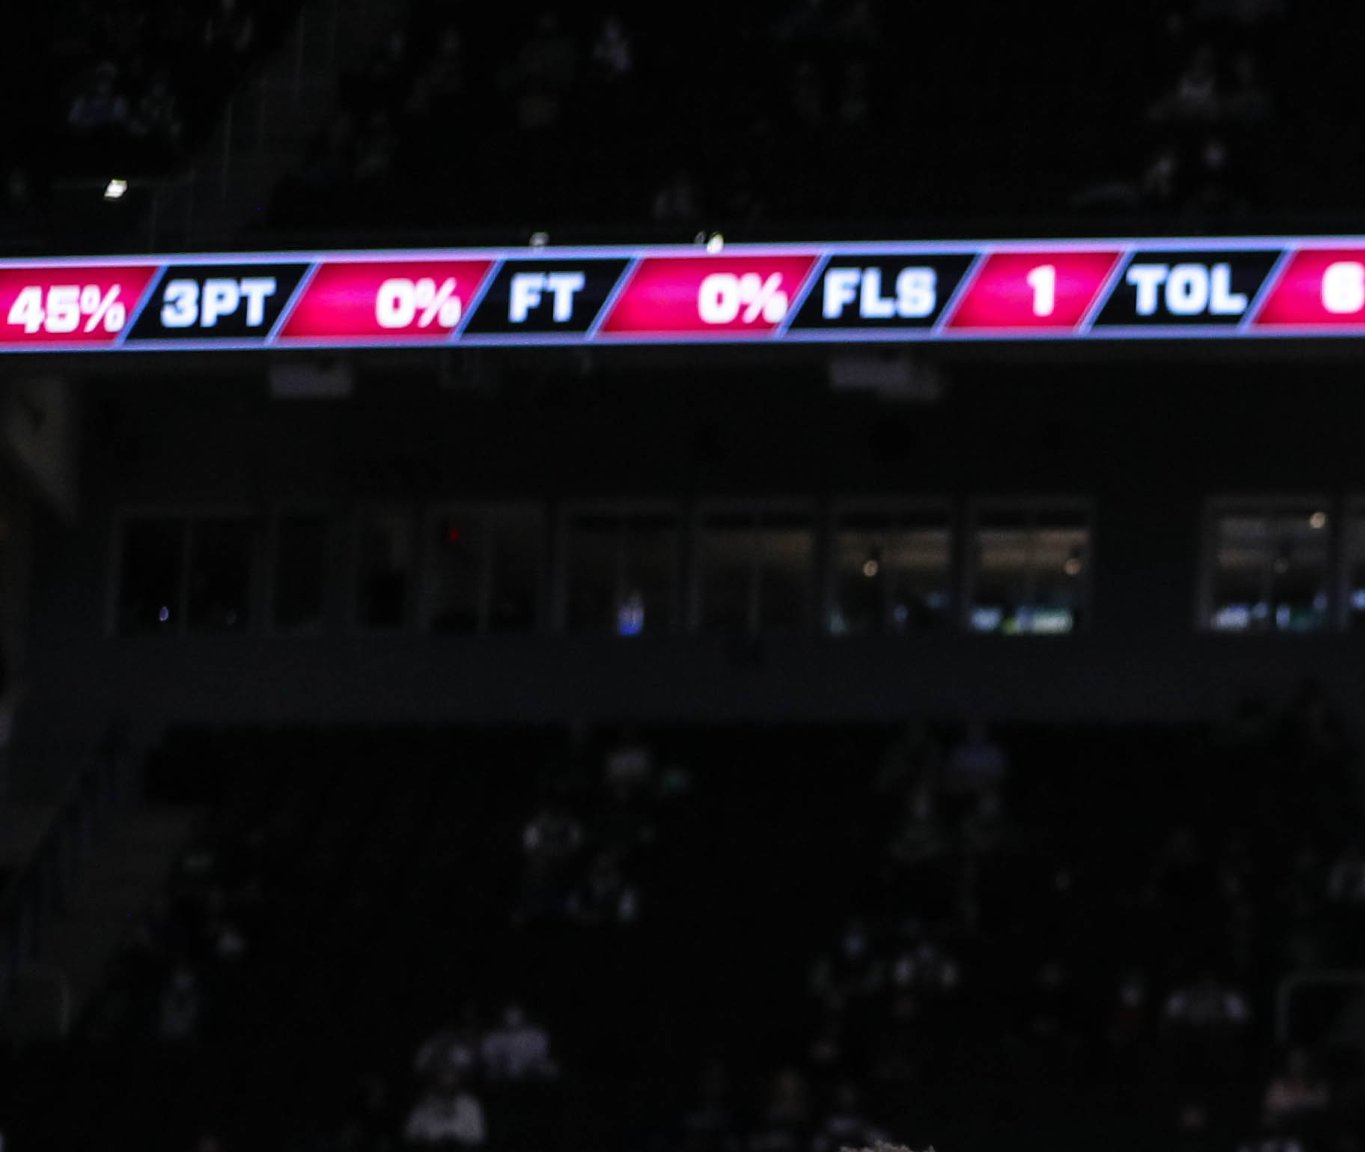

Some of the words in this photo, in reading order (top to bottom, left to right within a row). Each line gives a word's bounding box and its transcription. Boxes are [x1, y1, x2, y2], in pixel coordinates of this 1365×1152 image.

[7, 285, 127, 334] 45%
[161, 278, 277, 328] 3PT
[375, 278, 462, 328] 0%
[509, 273, 586, 323] FT
[698, 273, 789, 325] 0%
[823, 266, 937, 318] FLS
[1026, 265, 1055, 316] 1
[1127, 263, 1248, 315] TOL
